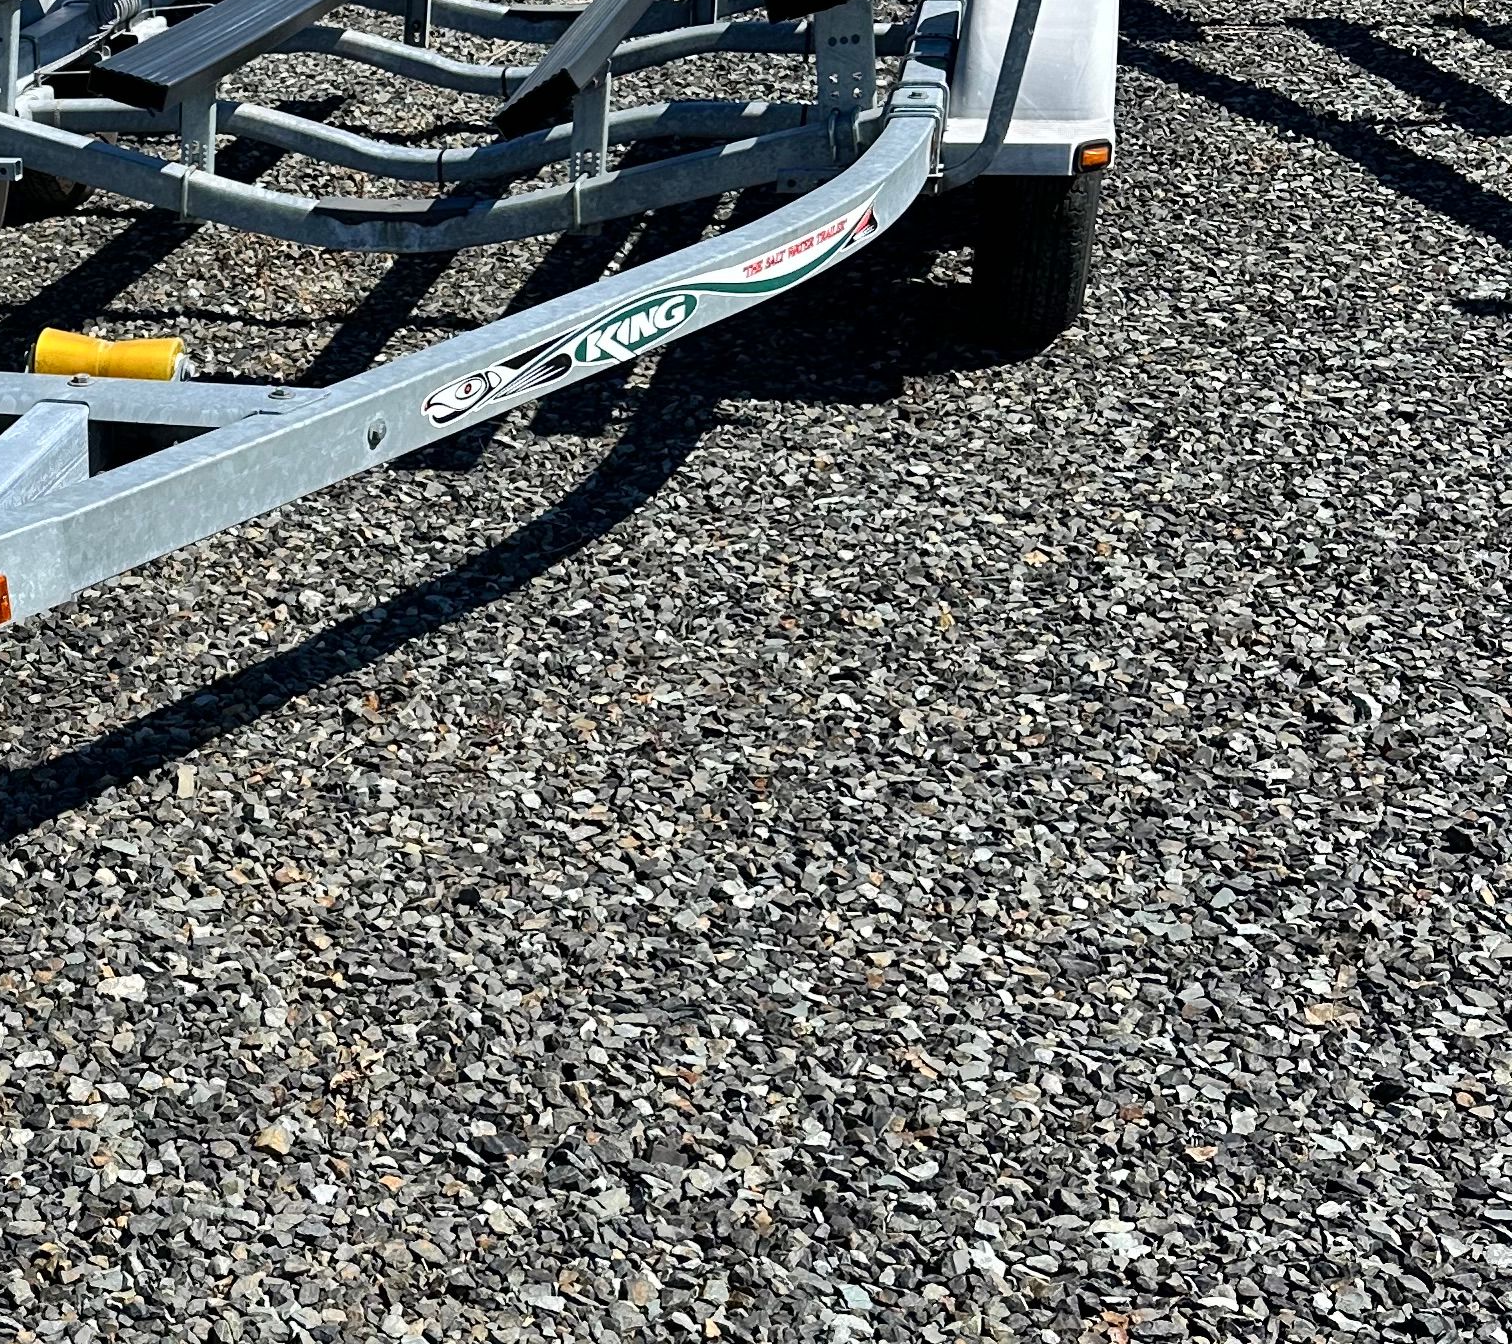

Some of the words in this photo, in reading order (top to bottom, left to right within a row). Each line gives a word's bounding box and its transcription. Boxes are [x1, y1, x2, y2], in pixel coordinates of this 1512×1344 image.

[764, 249, 786, 269] SALT
[788, 236, 815, 258] WATER
[585, 294, 687, 362] KING
